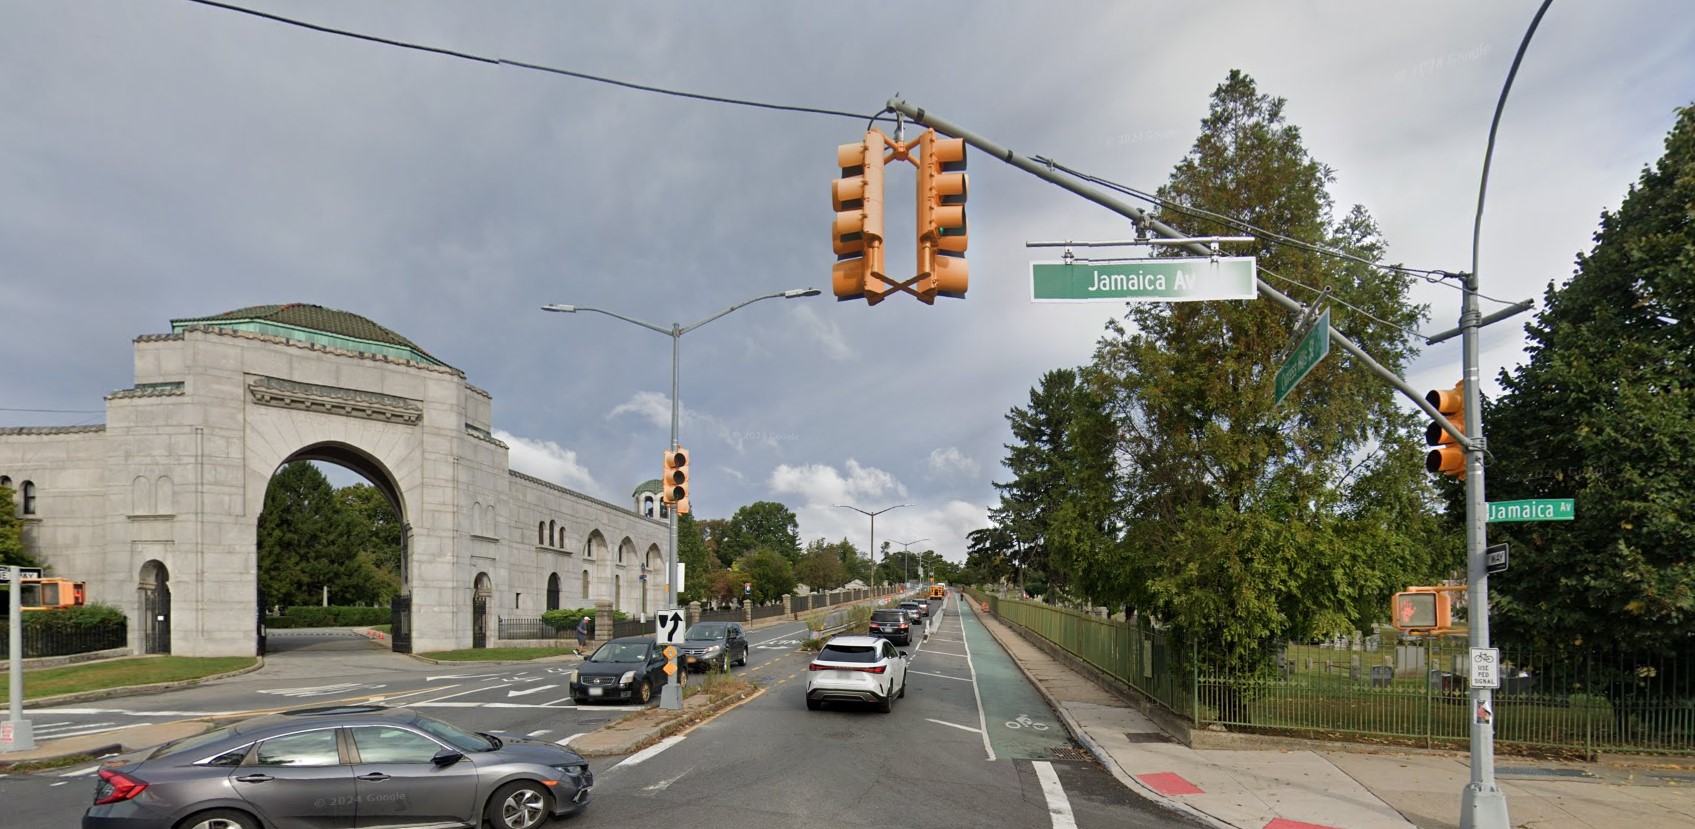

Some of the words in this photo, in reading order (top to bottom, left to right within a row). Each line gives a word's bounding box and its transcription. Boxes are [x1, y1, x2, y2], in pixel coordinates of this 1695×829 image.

[1088, 270, 1166, 291] Jamaica
[1173, 269, 1197, 291] Av
[1490, 500, 1554, 519] Jamaica
[1560, 500, 1572, 510] Av
